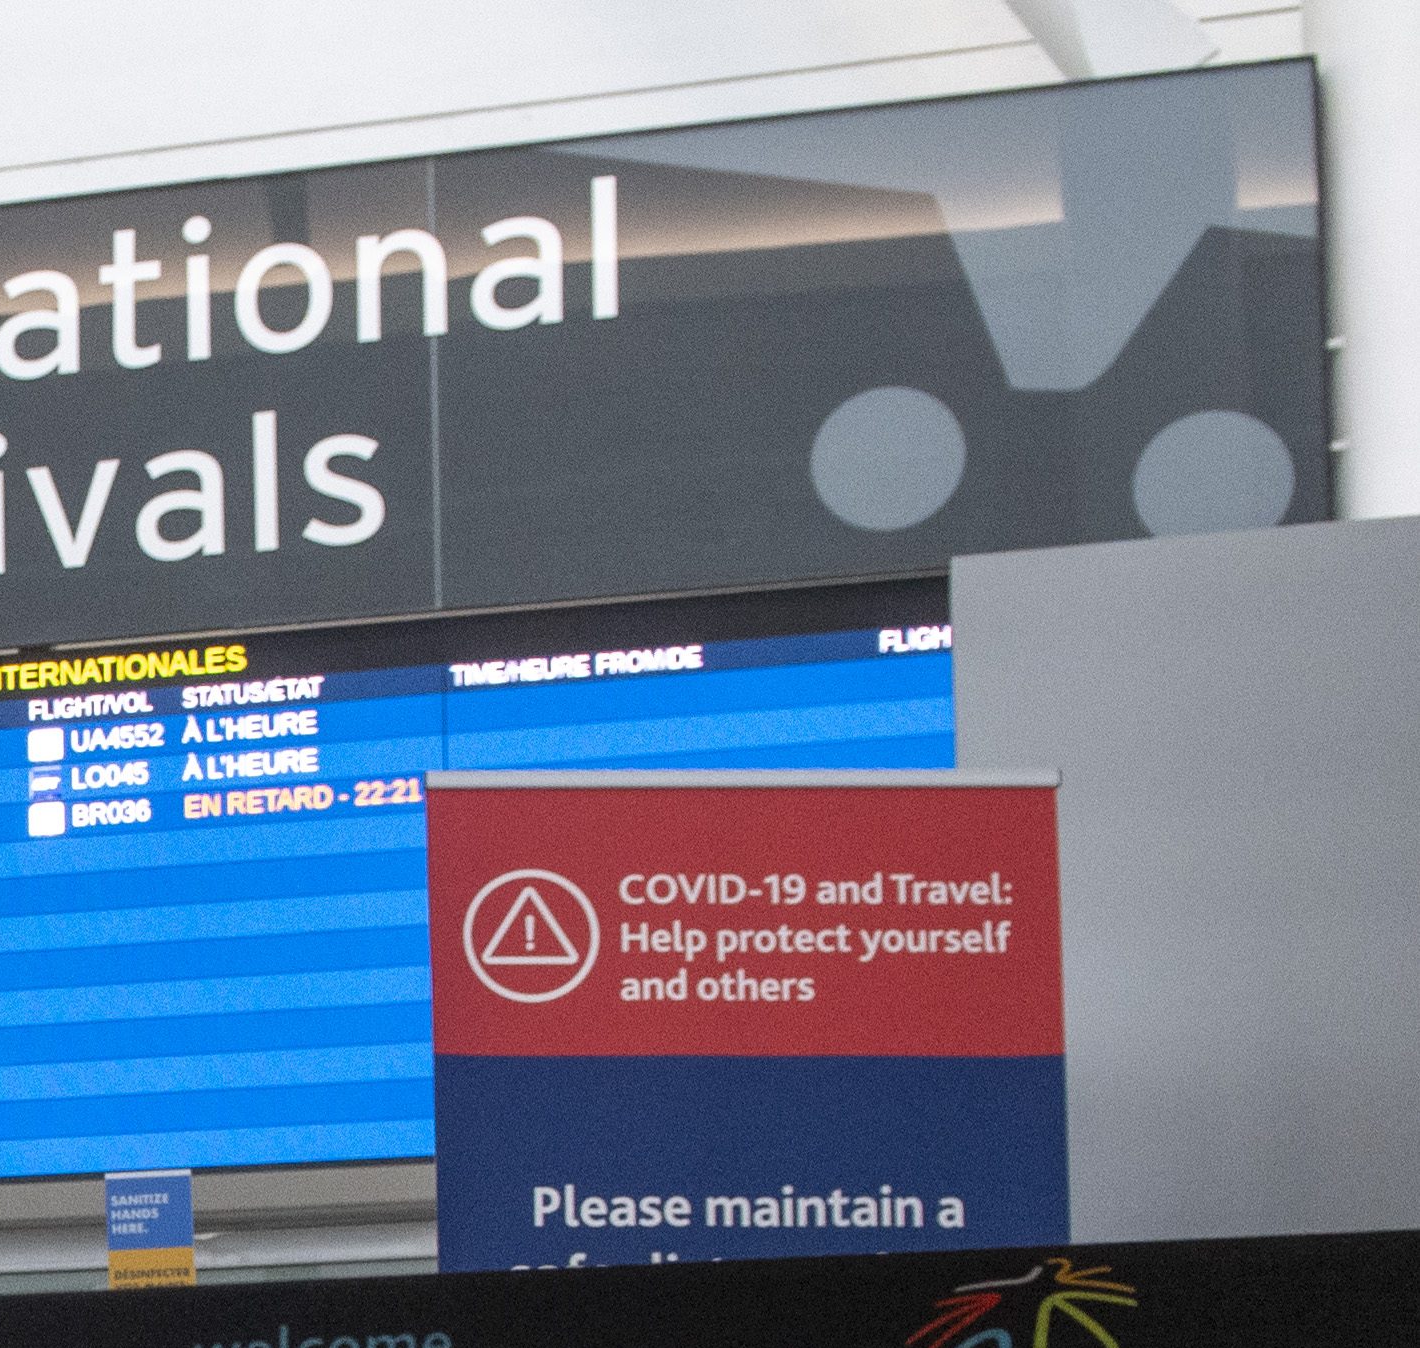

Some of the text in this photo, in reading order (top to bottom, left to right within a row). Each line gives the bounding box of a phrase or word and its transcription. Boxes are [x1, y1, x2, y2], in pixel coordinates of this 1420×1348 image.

[878, 625, 952, 653] FLIGH
[28, 691, 153, 721] FLIGHT/VOL
[71, 723, 164, 752] UA4552
[182, 715, 203, 743] À
[207, 710, 318, 741] L'HEURE
[72, 761, 149, 790] LO045
[182, 753, 203, 781] À
[207, 747, 319, 779] L'HEURE
[72, 799, 151, 827] BR036
[184, 794, 222, 818] EN
[227, 785, 334, 815] RETARD
[354, 778, 423, 806] 22:21
[619, 872, 1012, 905] COVID-19 and Travel:
[621, 920, 1011, 962] Help protect yourself
[620, 968, 815, 1001] and others
[111, 1208, 159, 1220] HANDS
[534, 1184, 963, 1228] Please maintain a
